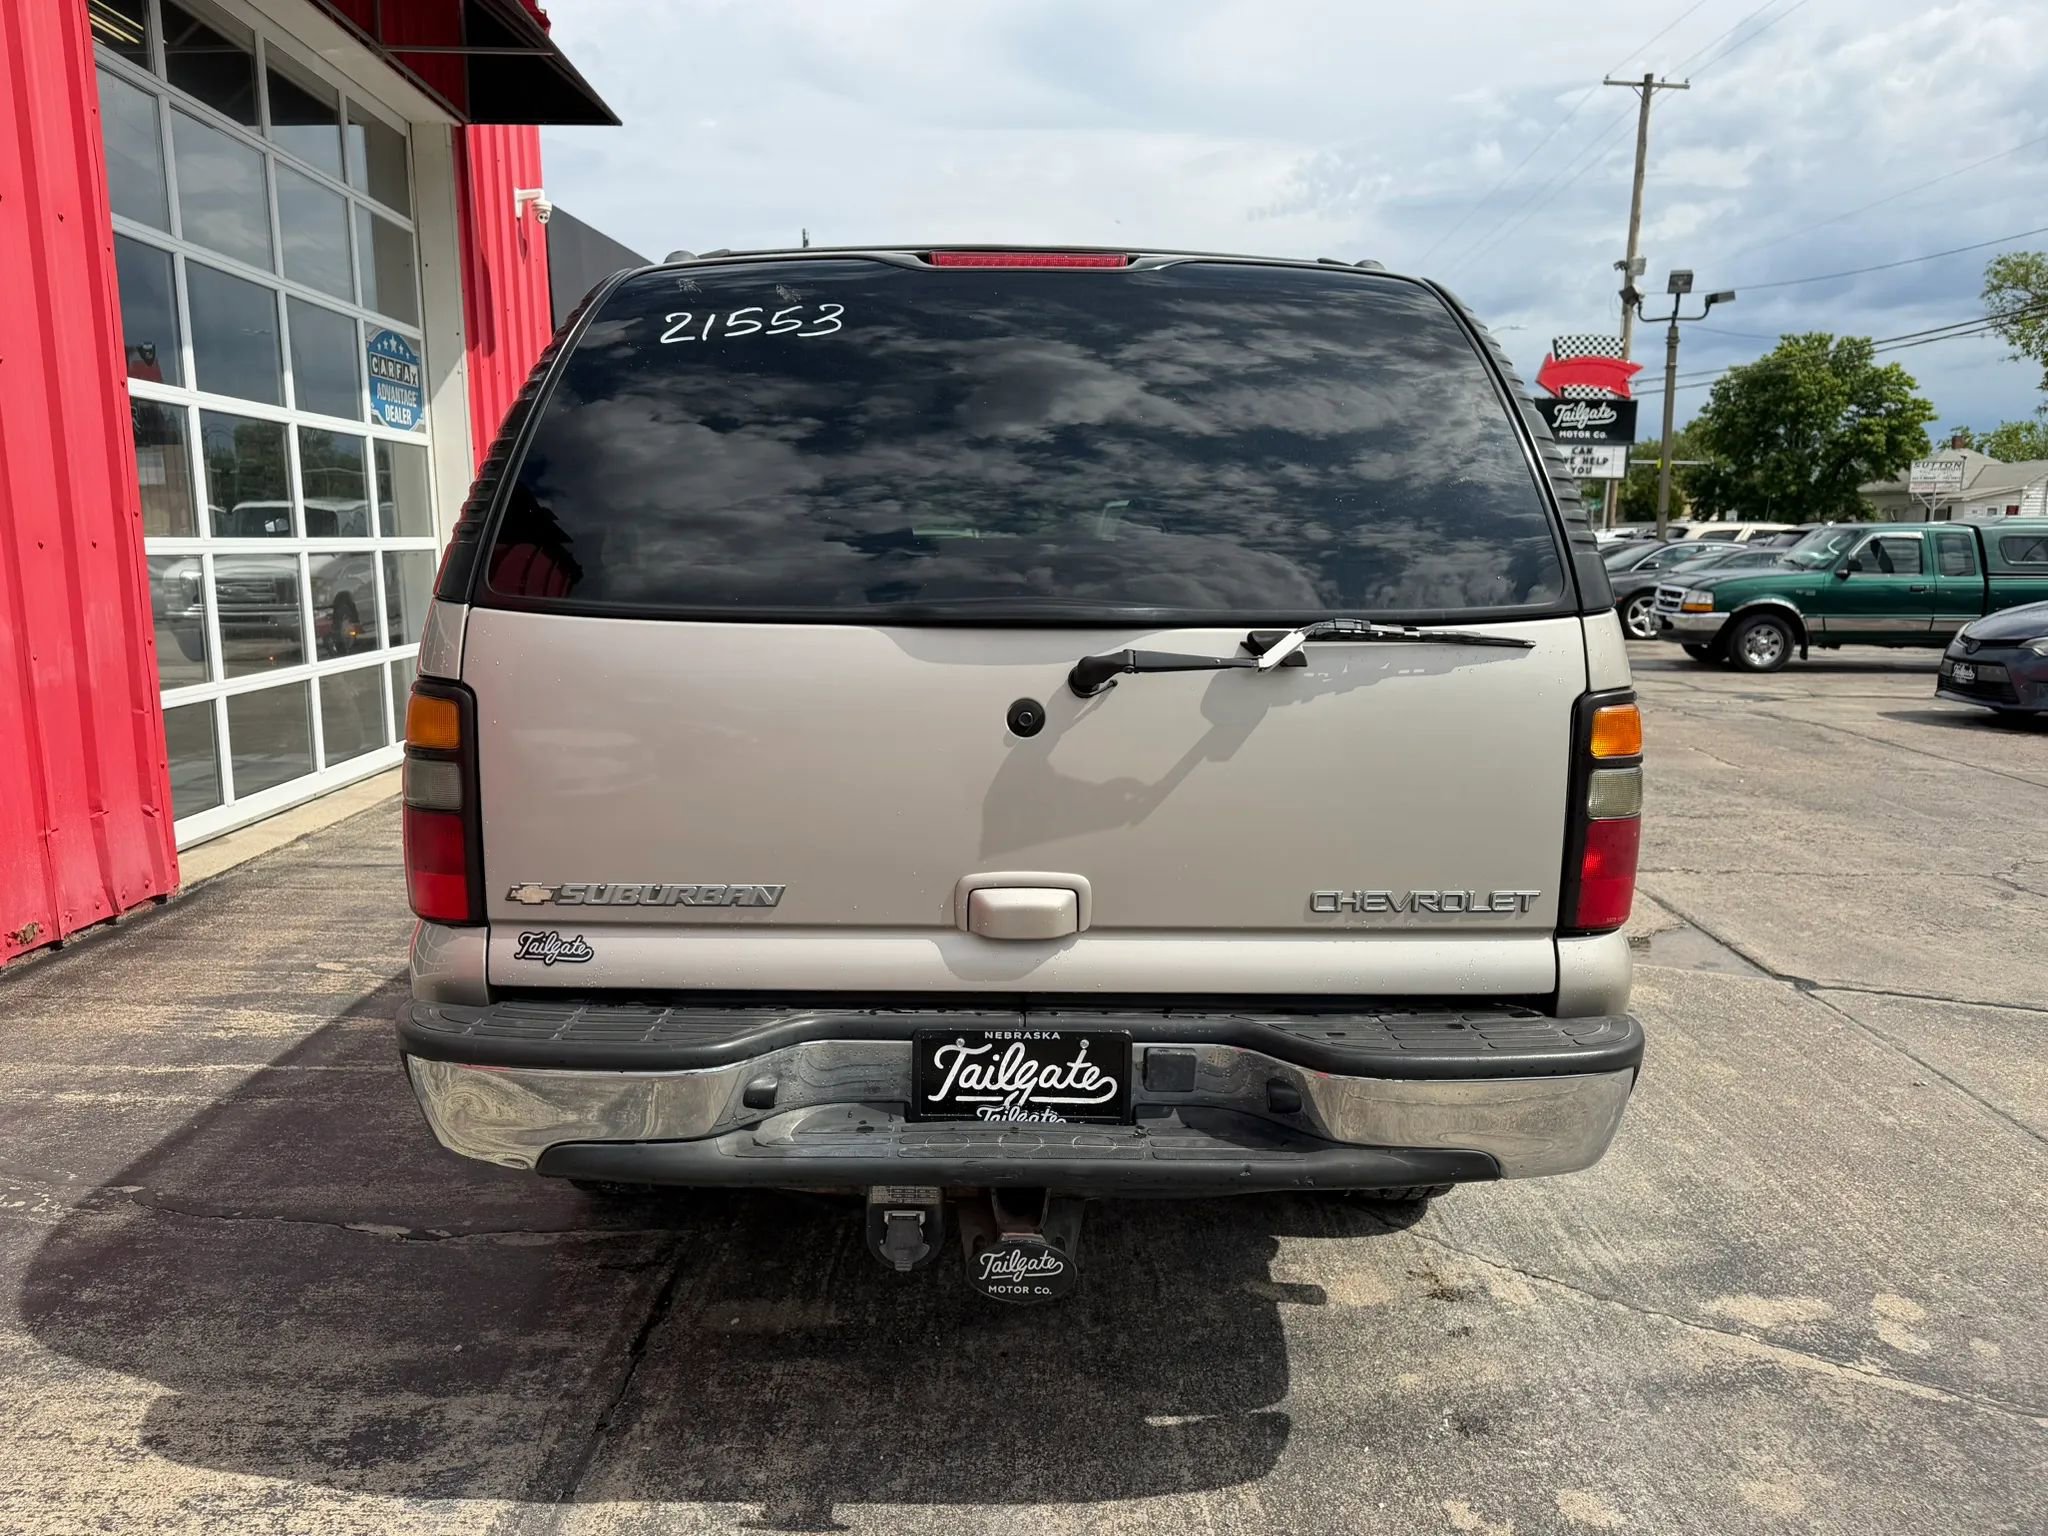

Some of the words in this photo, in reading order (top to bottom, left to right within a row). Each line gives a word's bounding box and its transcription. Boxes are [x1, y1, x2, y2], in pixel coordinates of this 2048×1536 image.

[660, 303, 845, 343] 21553
[372, 356, 418, 386] CARFAX
[376, 382, 418, 408] ADVANTAGE
[384, 404, 413, 425] DEALER
[1552, 401, 1617, 429] Tailgate
[1558, 430, 1591, 439] MOTOR
[1571, 446, 1593, 455] CAN
[1582, 456, 1609, 465] HELP
[1571, 466, 1593, 474] YOU
[555, 883, 787, 907] SUBURBAN
[1310, 890, 1541, 912] CHEVROLET
[514, 931, 594, 965] Tailgate
[984, 1031, 1061, 1040] NEBRASKA
[928, 1041, 1118, 1107] Tailgate
[978, 1249, 1064, 1282] Tailgate
[988, 1285, 1030, 1294] MOTOR
